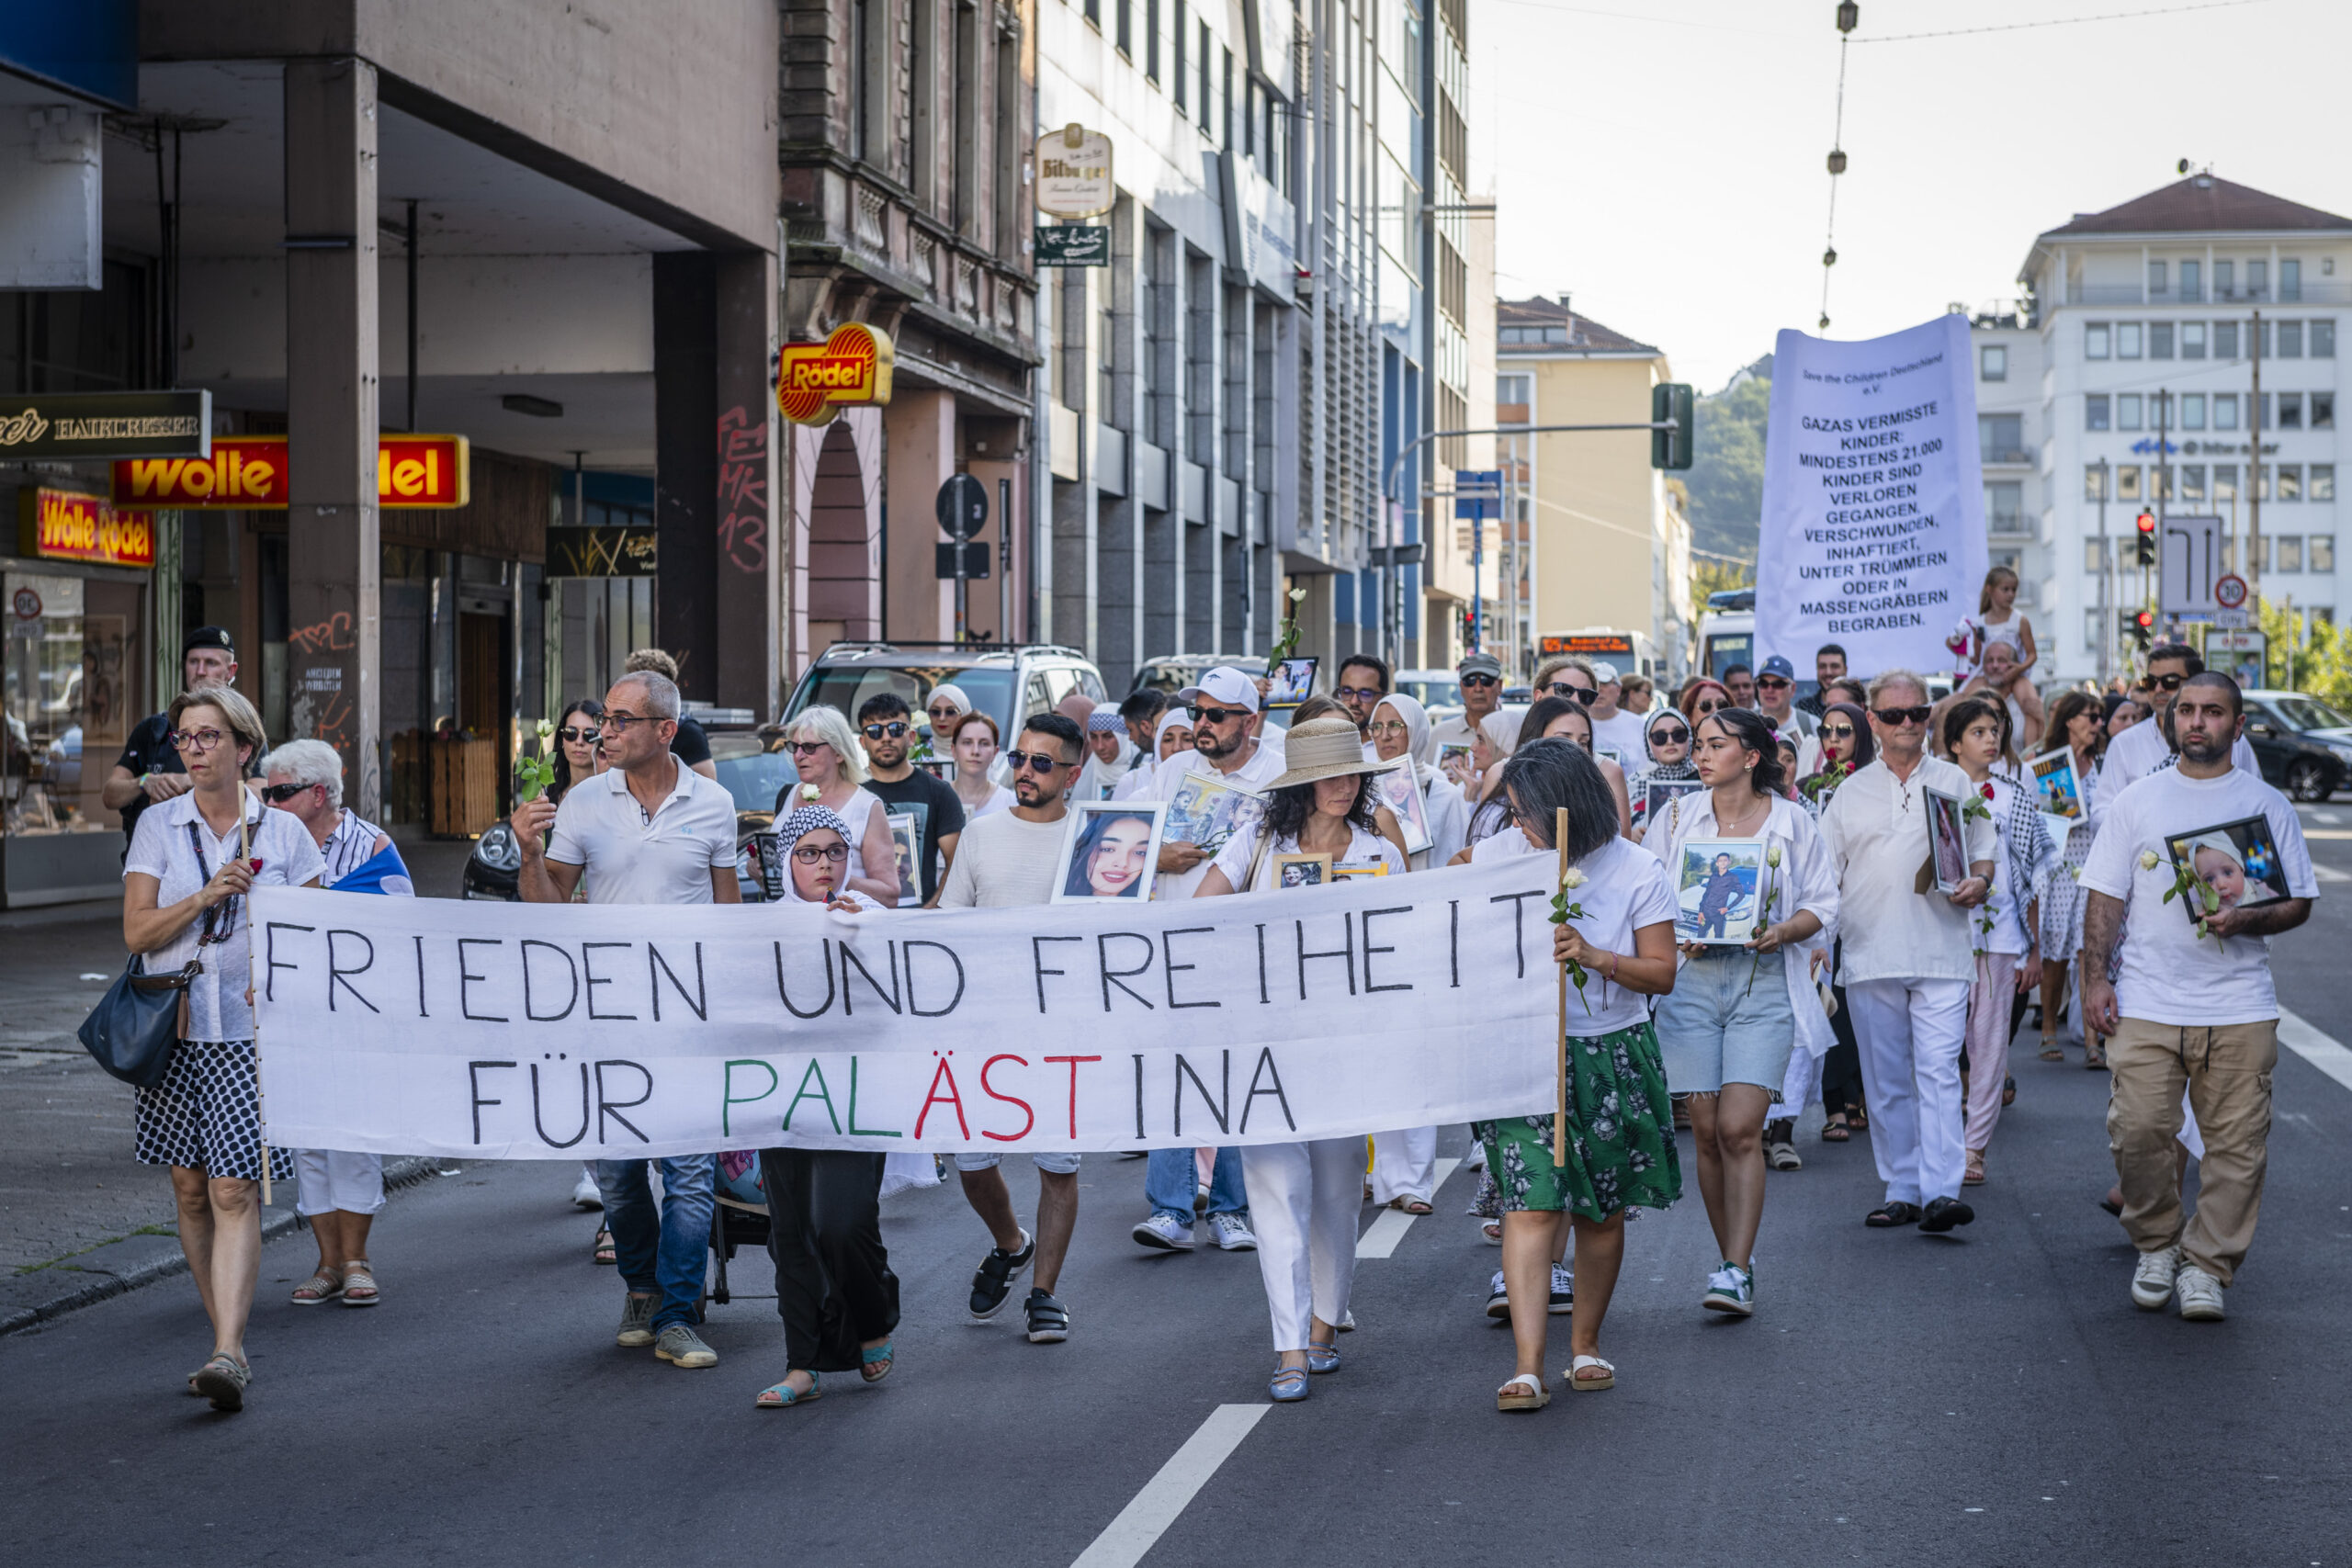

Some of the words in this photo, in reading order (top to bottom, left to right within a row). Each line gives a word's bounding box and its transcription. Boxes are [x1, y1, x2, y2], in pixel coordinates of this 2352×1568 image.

[793, 361, 862, 391] Rödel
[1803, 369, 1822, 382] Save
[1825, 374, 1840, 384] the
[1844, 370, 1888, 384] Children
[1890, 353, 1943, 377] Deutschland
[1802, 416, 1853, 433] GAZAS
[1858, 400, 1939, 431] VERMISSTE
[1800, 449, 1898, 469] MINDESTENS
[1902, 437, 1943, 460] 21.000
[1840, 431, 1904, 450] KINDER:
[132, 449, 275, 497] Wolle
[1823, 470, 1884, 488] KINDER
[1888, 463, 1922, 481] SIND
[1830, 483, 1917, 505] VERLOREN
[44, 493, 96, 550] Wolle
[1804, 514, 1939, 543] VERSCHWUNDEN,
[718, 513, 766, 572] 13
[1827, 537, 1920, 561] INHAFTIERT,
[1799, 565, 1854, 580] UNTER
[1859, 551, 1948, 576] TRÜMMERN
[1842, 581, 1889, 595] ODER
[1894, 577, 1907, 590] IN
[2222, 583, 2241, 600] 30
[1800, 589, 1949, 615] MASSENGRÄBERN
[1828, 612, 1926, 634] BEGRABEN.
[266, 921, 708, 1022] FRIEDEN
[775, 938, 966, 1020] UND
[1032, 889, 1546, 1014] FREIHEIT
[469, 1052, 654, 1148] FÜR
[721, 1045, 1296, 1142] PALÄSTINA
